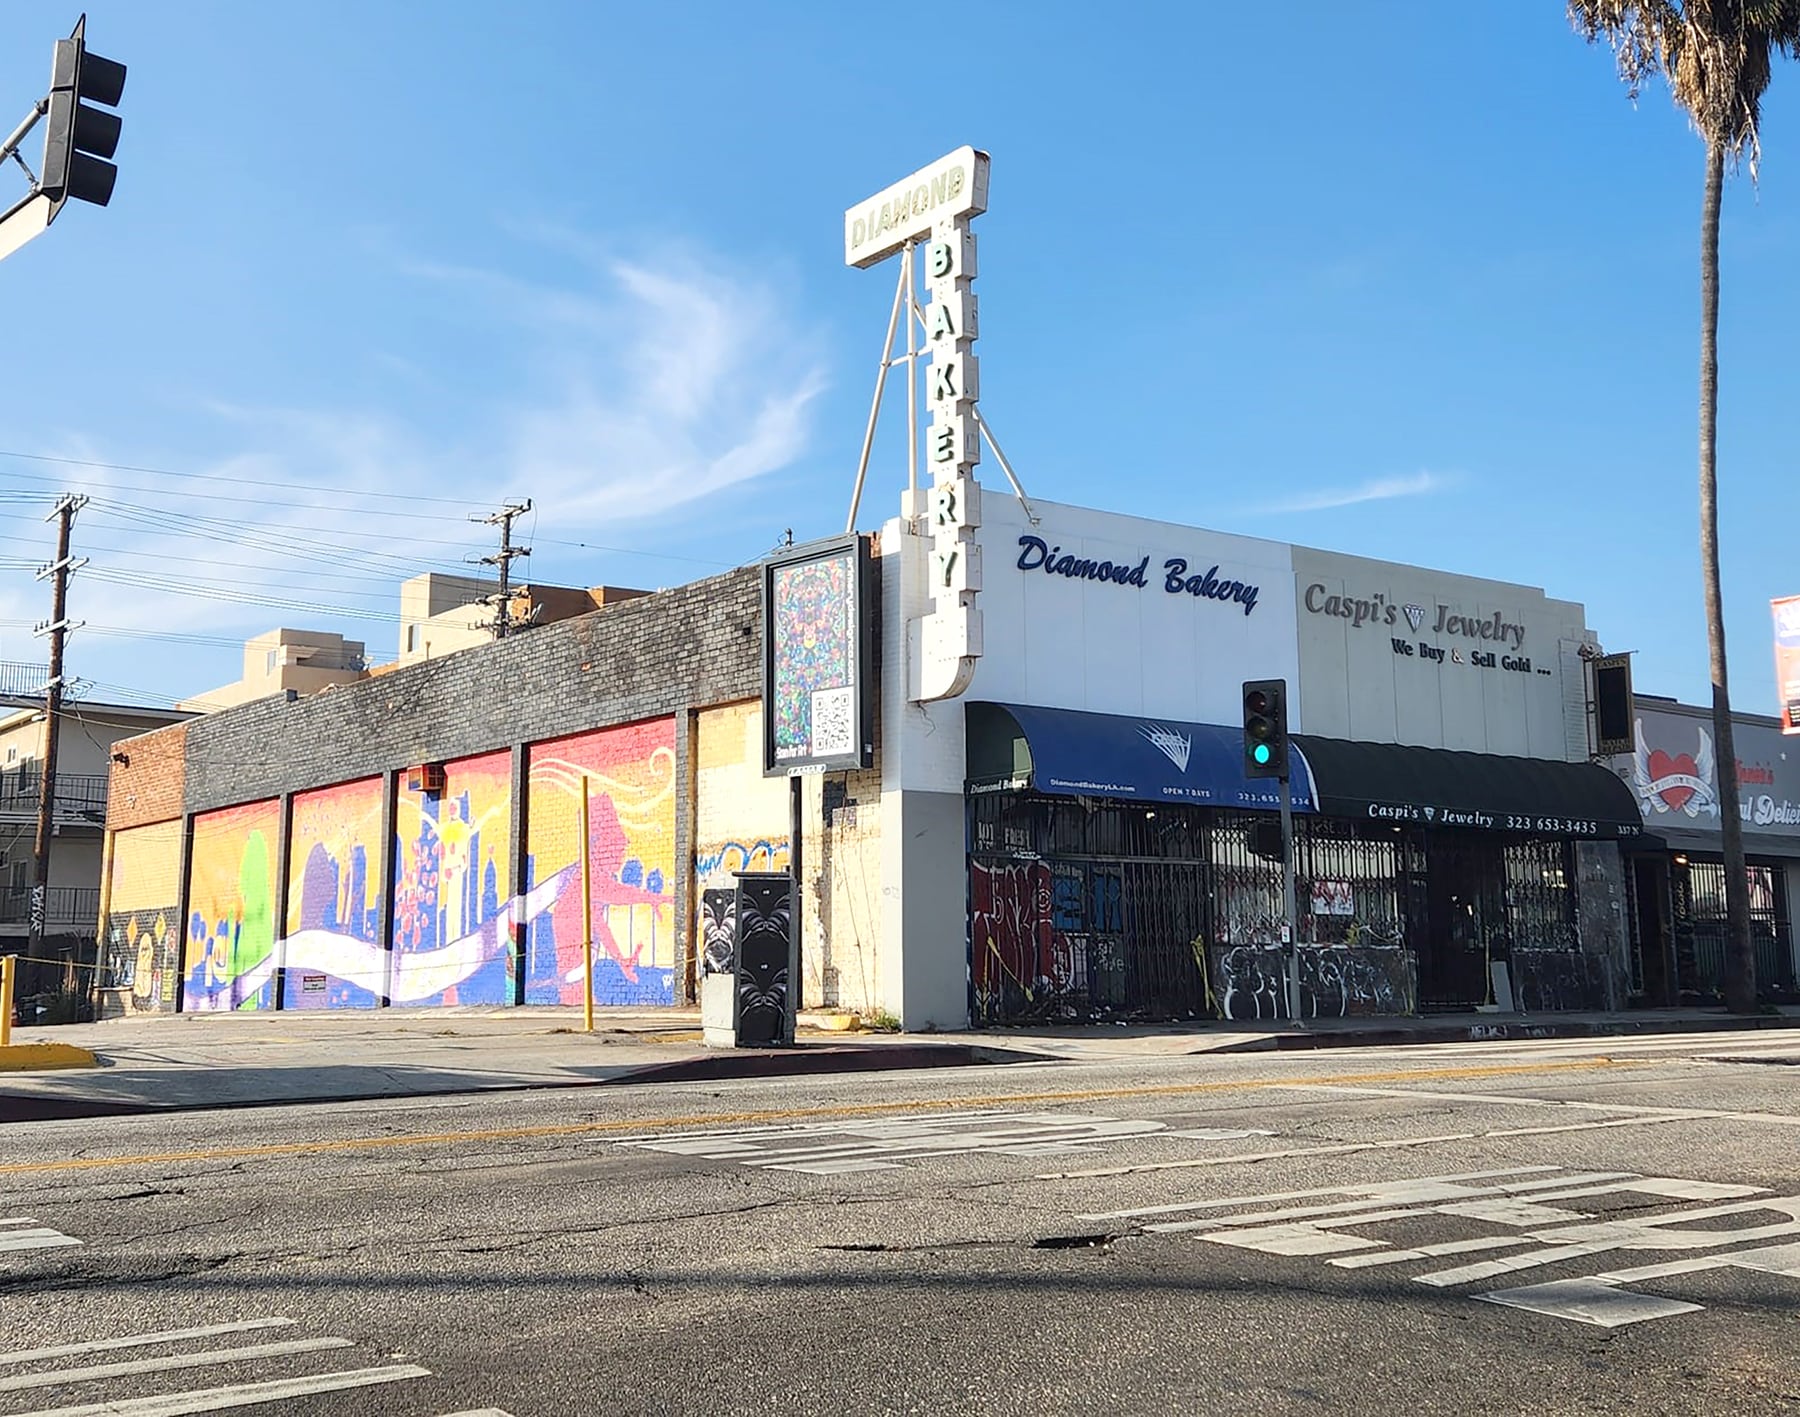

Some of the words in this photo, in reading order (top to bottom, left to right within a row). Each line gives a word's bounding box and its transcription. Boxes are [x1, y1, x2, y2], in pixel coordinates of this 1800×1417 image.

[851, 165, 965, 250] DIAMOND
[932, 242, 958, 588] BAKERY
[1017, 535, 1150, 588] Diamond
[1163, 558, 1259, 616] Bakery
[1304, 583, 1397, 628] Caspi's
[1432, 604, 1526, 651] Jewelry
[1391, 637, 1413, 656] We
[1419, 642, 1445, 664] Buy
[1451, 648, 1465, 664] &
[1471, 651, 1496, 668] Sell
[1501, 655, 1531, 673] Gold
[970, 779, 1002, 794] Diamond
[1162, 786, 1183, 796] OPEN
[1190, 789, 1211, 799] DAYS
[1368, 803, 1418, 821] Caspi's
[1439, 808, 1495, 828] Jewelry
[1506, 815, 1531, 830] 323
[1536, 816, 1598, 834] 653-3435
